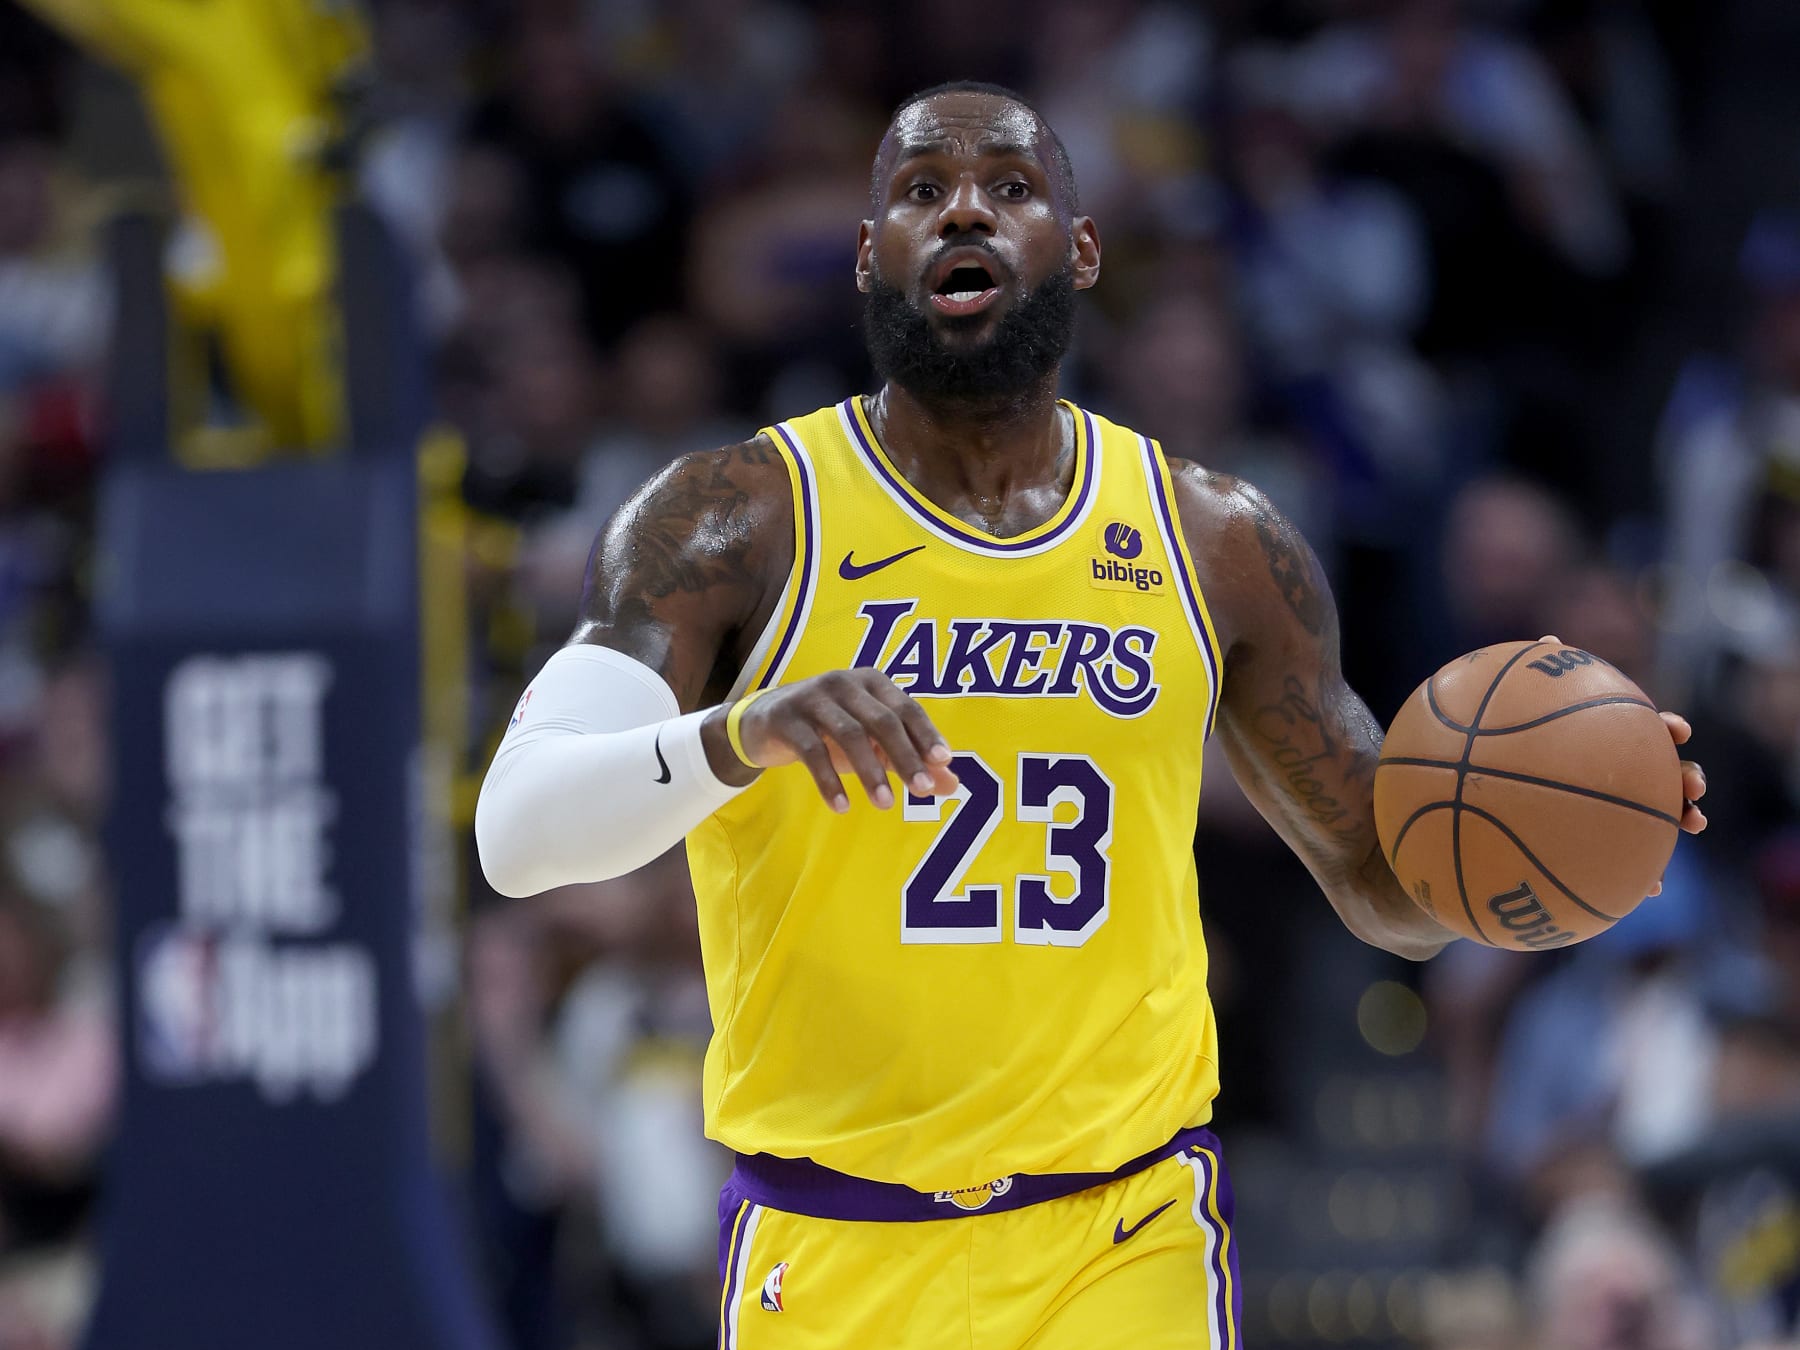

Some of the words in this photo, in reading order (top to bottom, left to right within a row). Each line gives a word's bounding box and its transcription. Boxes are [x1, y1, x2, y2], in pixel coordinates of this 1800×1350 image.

[1092, 558, 1163, 591] bibigo
[851, 598, 1162, 720] LAKERS
[900, 750, 1116, 948] 23
[1487, 879, 1578, 951] Wil
